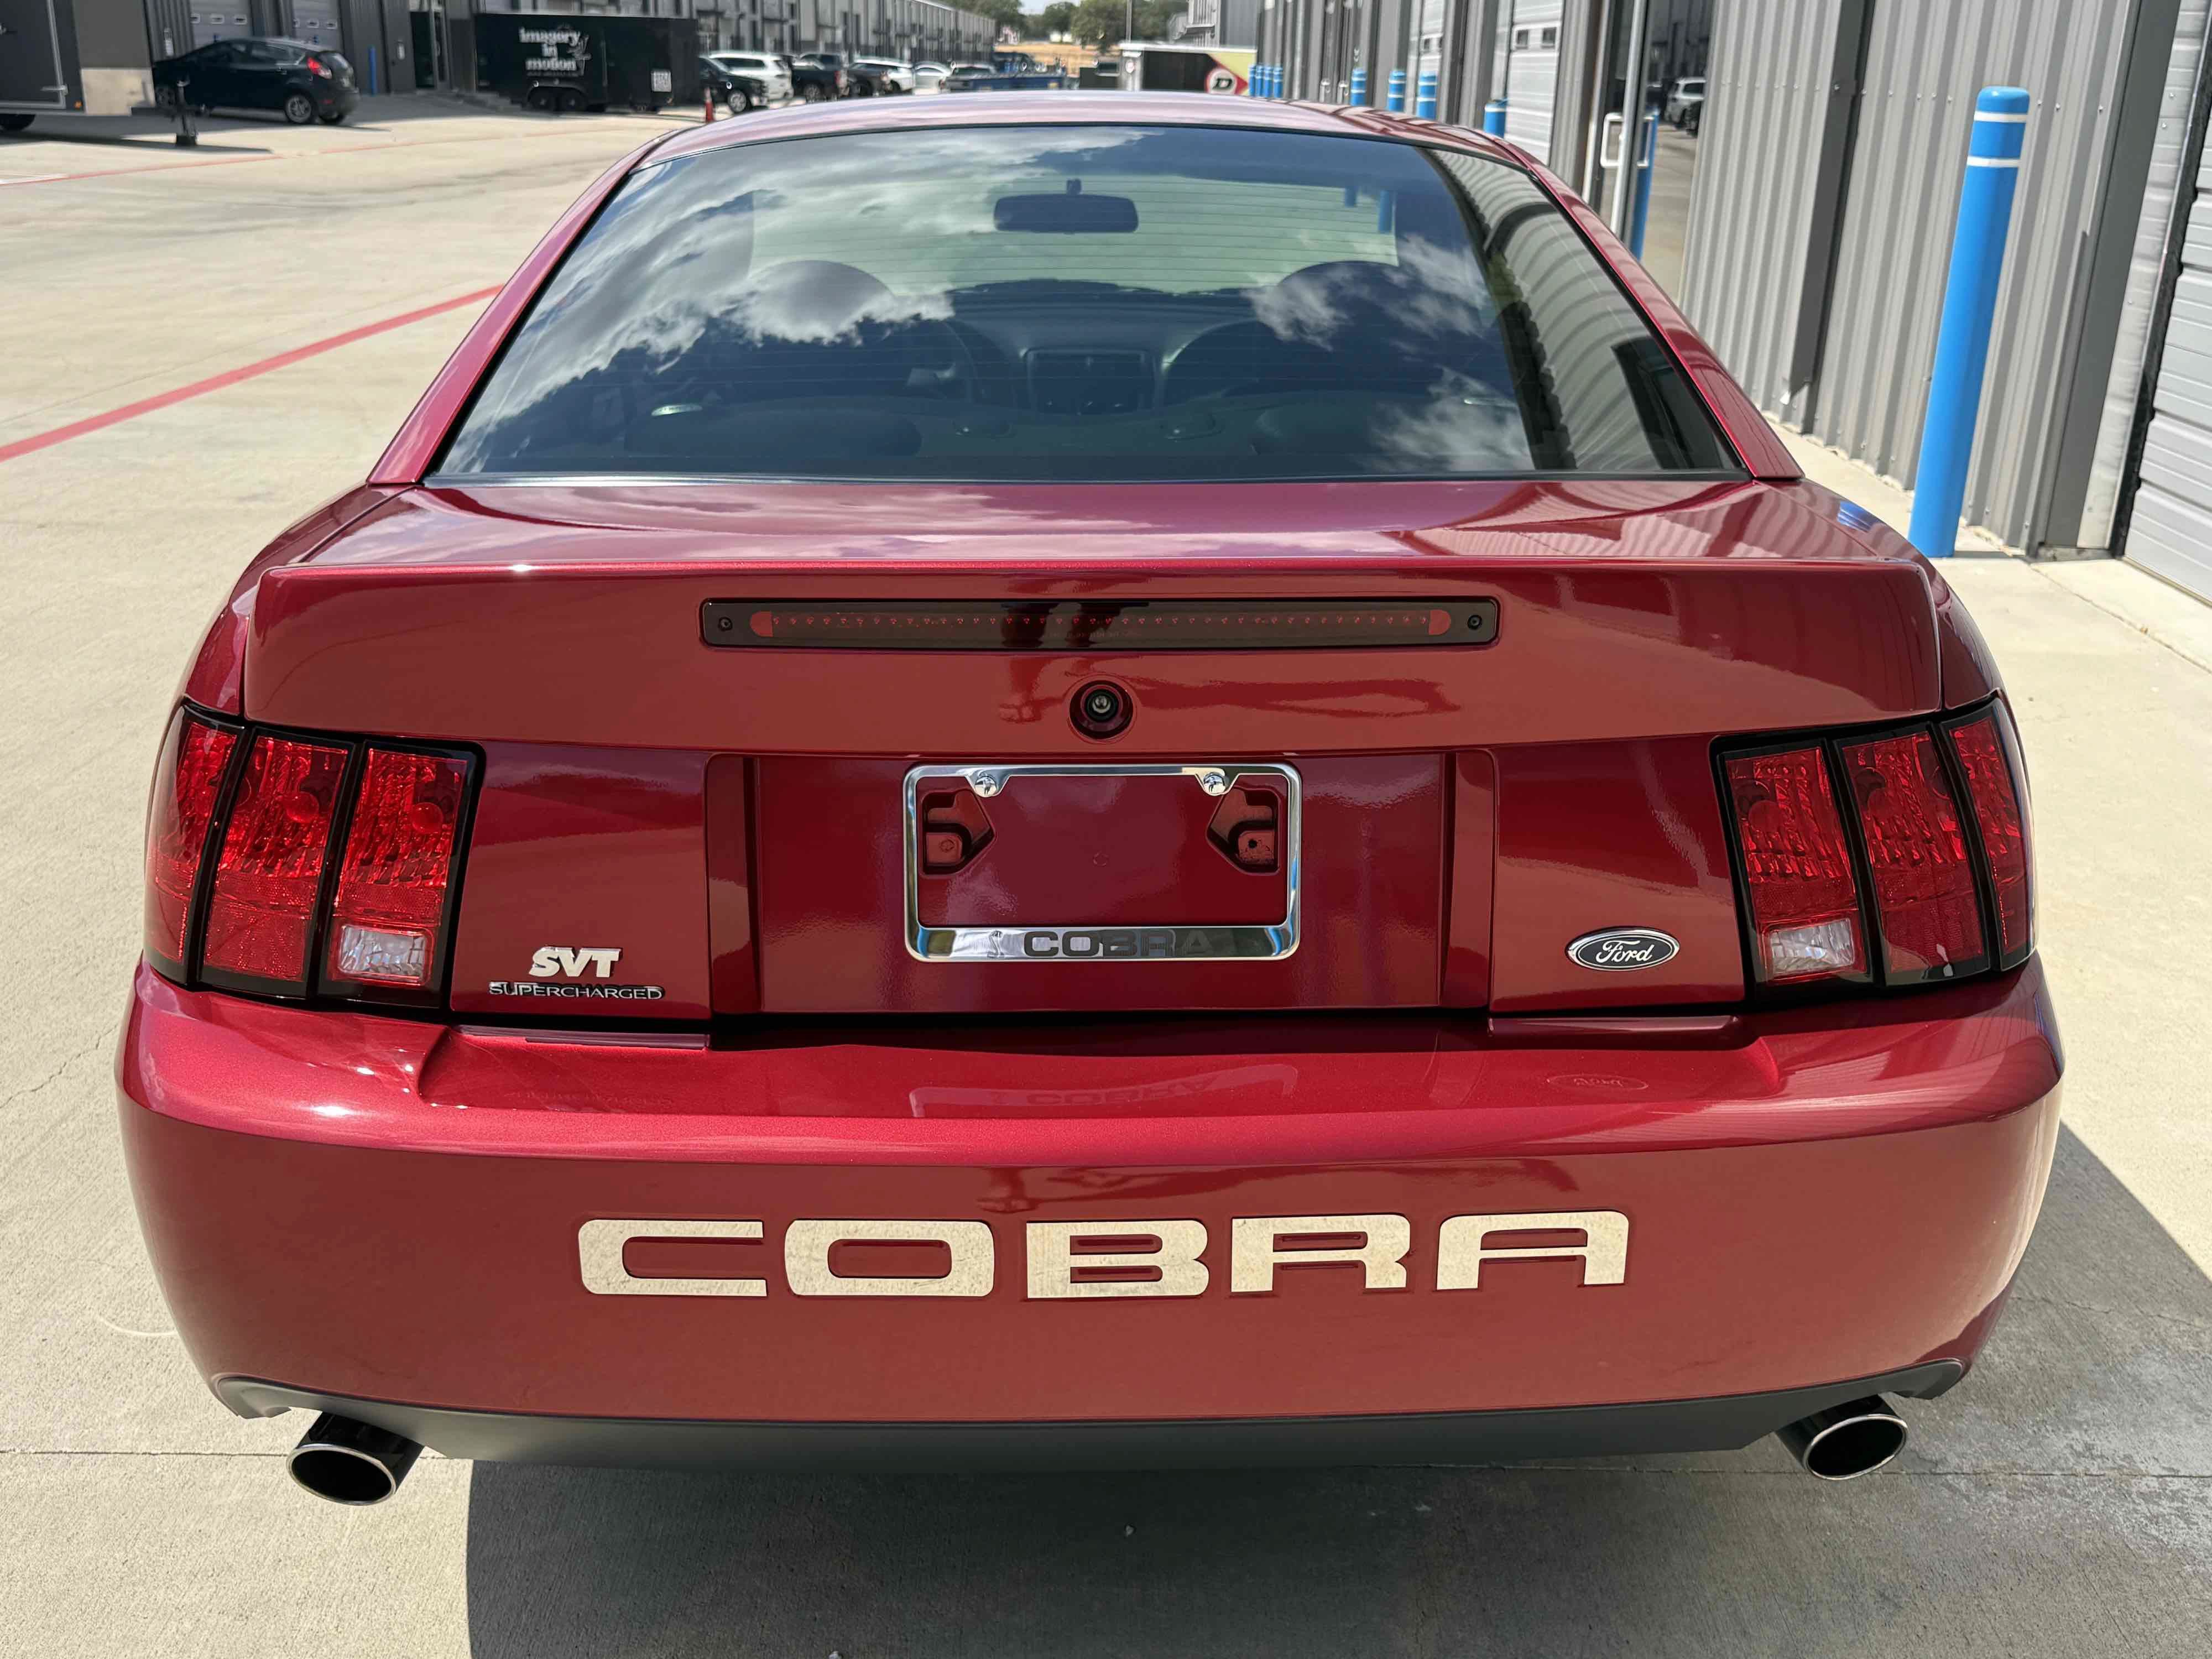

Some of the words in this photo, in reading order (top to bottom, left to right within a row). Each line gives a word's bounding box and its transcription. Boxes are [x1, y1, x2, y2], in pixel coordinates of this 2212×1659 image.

[1024, 929, 1215, 957] COBRA
[1596, 940, 1655, 963] Ford
[528, 945, 621, 978] SVT
[489, 982, 662, 1000] SUPERCHARGED
[577, 1211, 1630, 1300] COBRA
